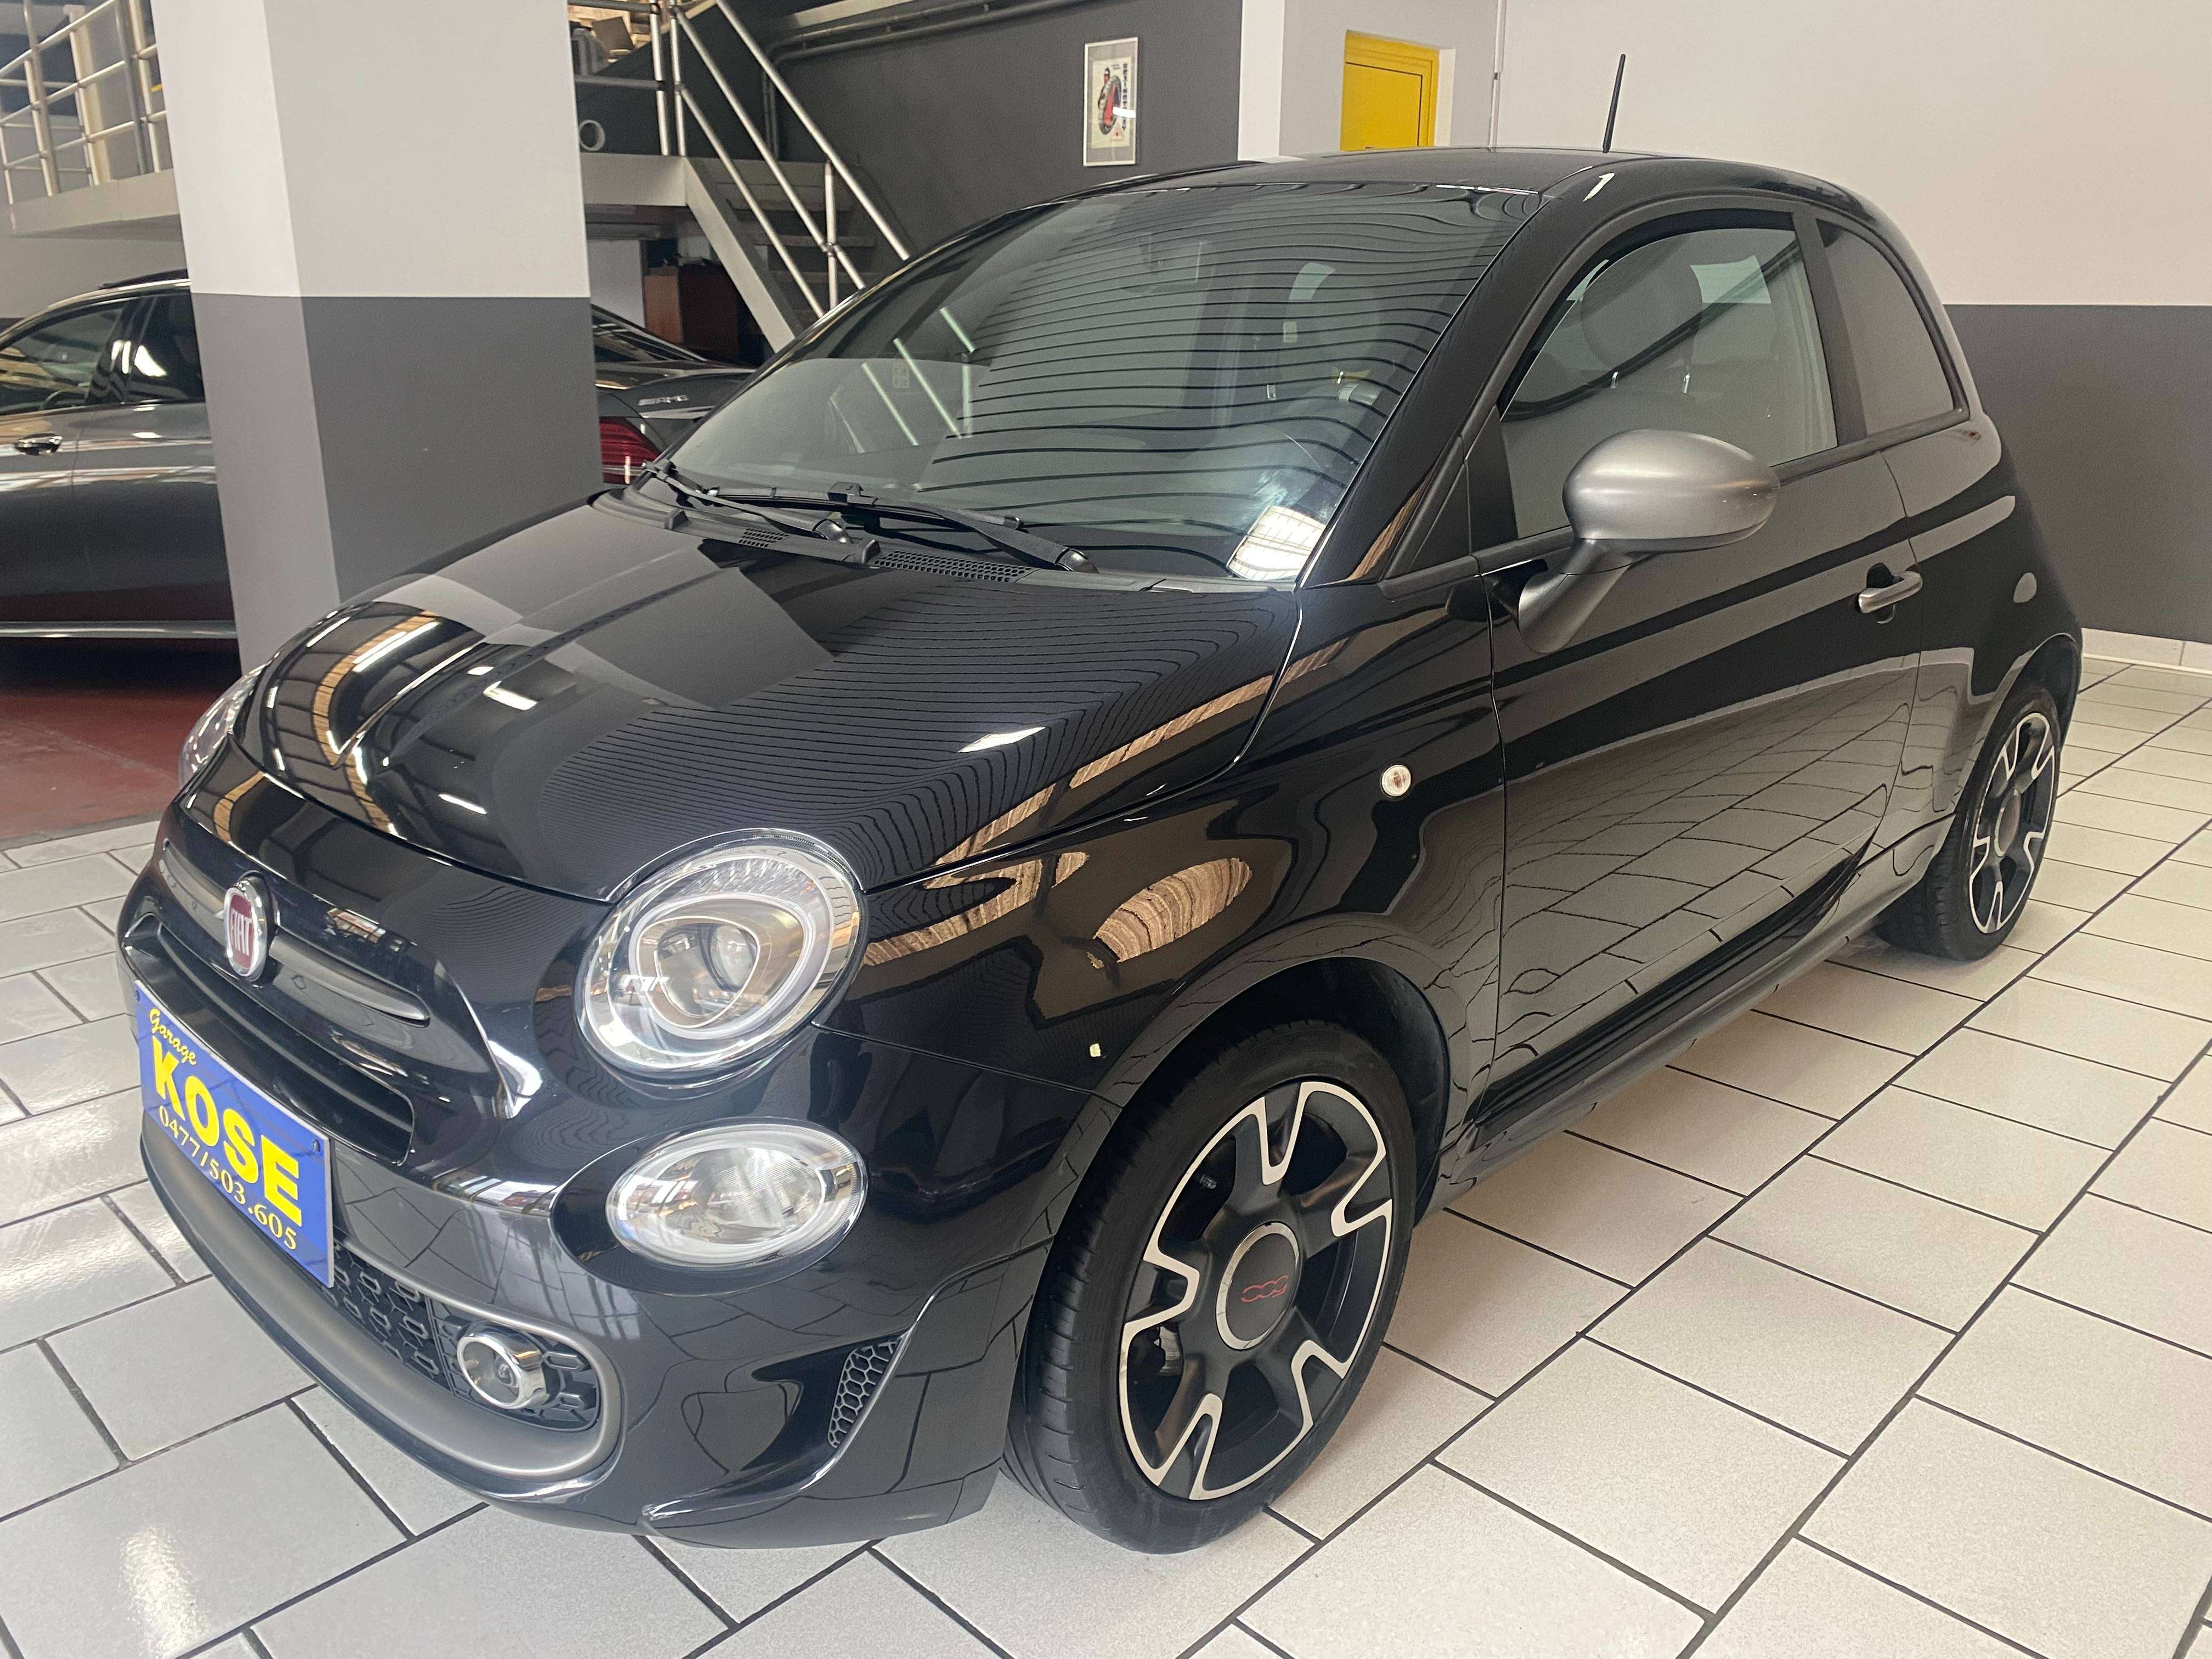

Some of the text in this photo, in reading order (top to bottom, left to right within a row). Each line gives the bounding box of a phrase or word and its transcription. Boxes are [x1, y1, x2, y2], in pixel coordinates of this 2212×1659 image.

[230, 907, 252, 956] FIAT
[149, 1008, 197, 1066] Garage
[152, 1035, 302, 1227] KOSE
[159, 1105, 297, 1250] 0477/503.605
